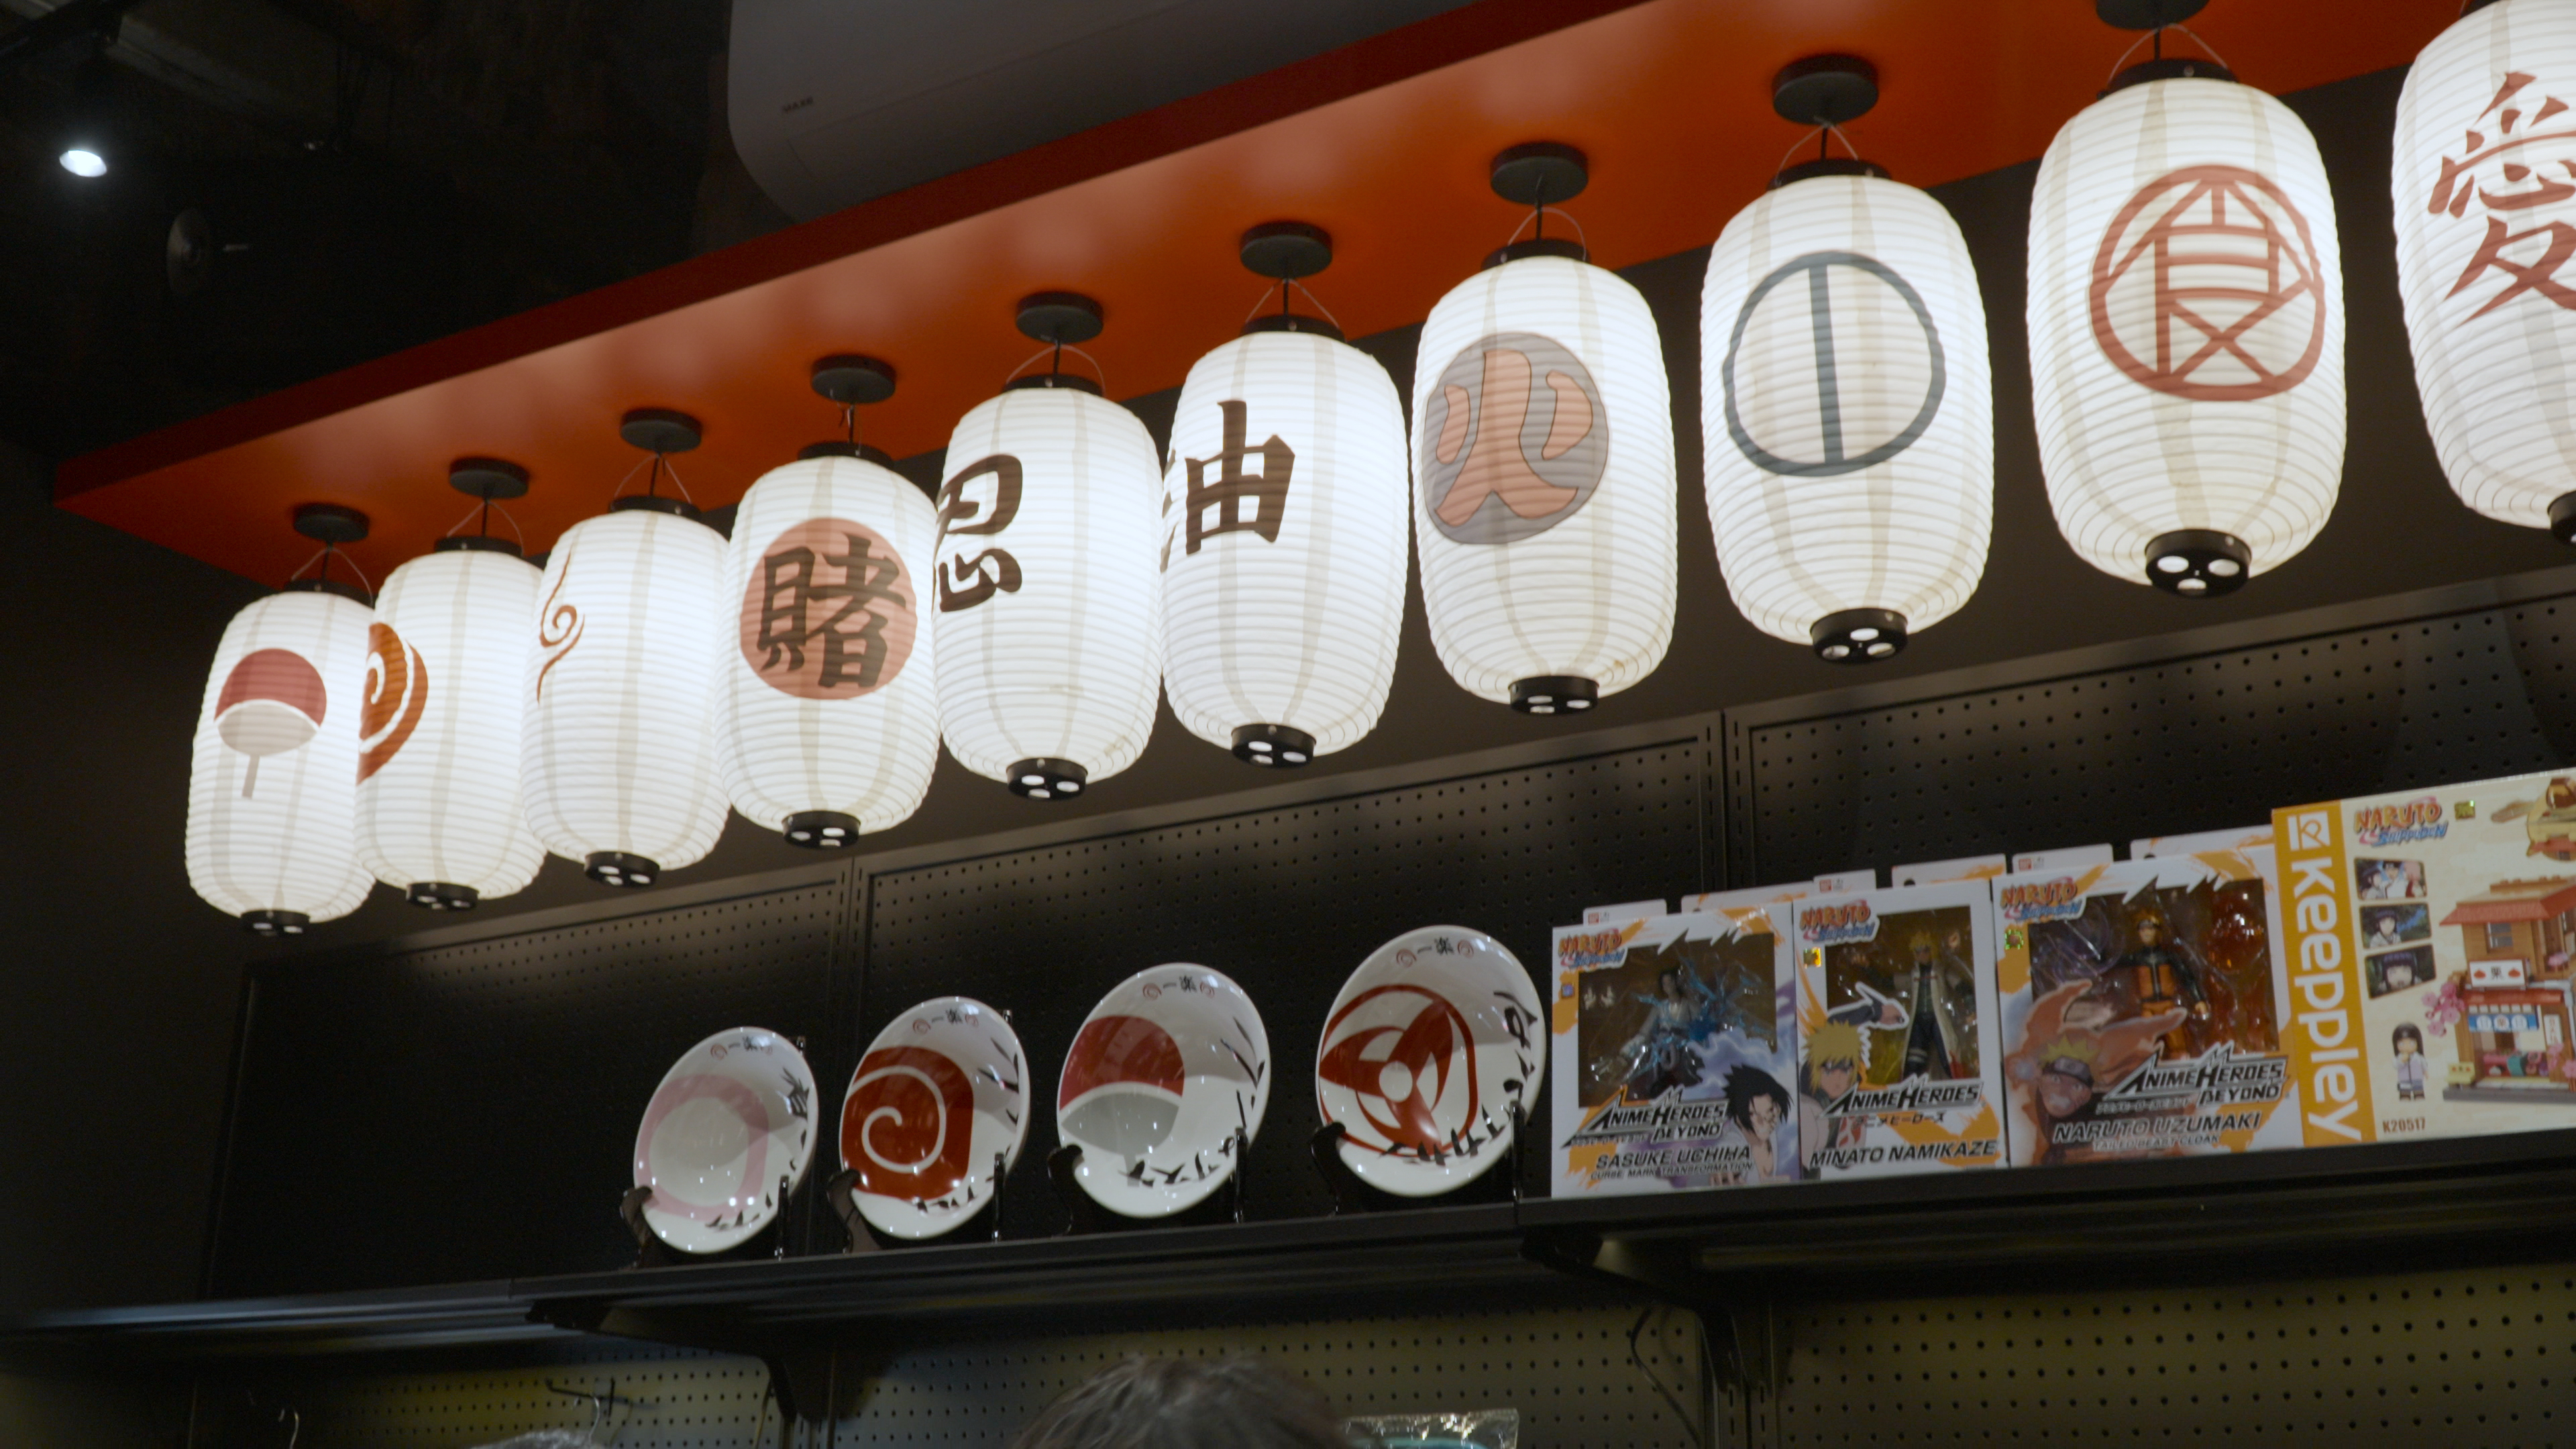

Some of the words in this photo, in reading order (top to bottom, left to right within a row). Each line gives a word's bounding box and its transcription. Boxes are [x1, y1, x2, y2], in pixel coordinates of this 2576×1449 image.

[1435, 348, 1594, 527] 火
[755, 533, 907, 688] 賭
[2354, 802, 2442, 833] NARUTO
[2000, 882, 2077, 908] NARUTO
[1800, 905, 1870, 931] NARUTO
[1558, 933, 1621, 957] NARUTO
[2291, 857, 2362, 1142] Keeppley
[2114, 1051, 2198, 1095] ANIME
[2196, 1048, 2286, 1088] HEROES
[1583, 1089, 1653, 1132] ANIME
[1650, 1087, 1726, 1128] HEROES
[1822, 1082, 1898, 1116] ANIME
[1897, 1075, 1980, 1109] HEROES
[2198, 1085, 2281, 1106] BEYOND
[1652, 1123, 1722, 1142] BEYOND
[2053, 1118, 2150, 1143] NARUTO
[2154, 1111, 2262, 1135] UZUMAKI
[2382, 1116, 2426, 1134] K20517
[1595, 1148, 1674, 1170] SASUKE
[1677, 1145, 1752, 1164] UCHIHA
[1810, 1147, 1884, 1167] MINATO
[1888, 1139, 1998, 1161] NAMIKAZE
